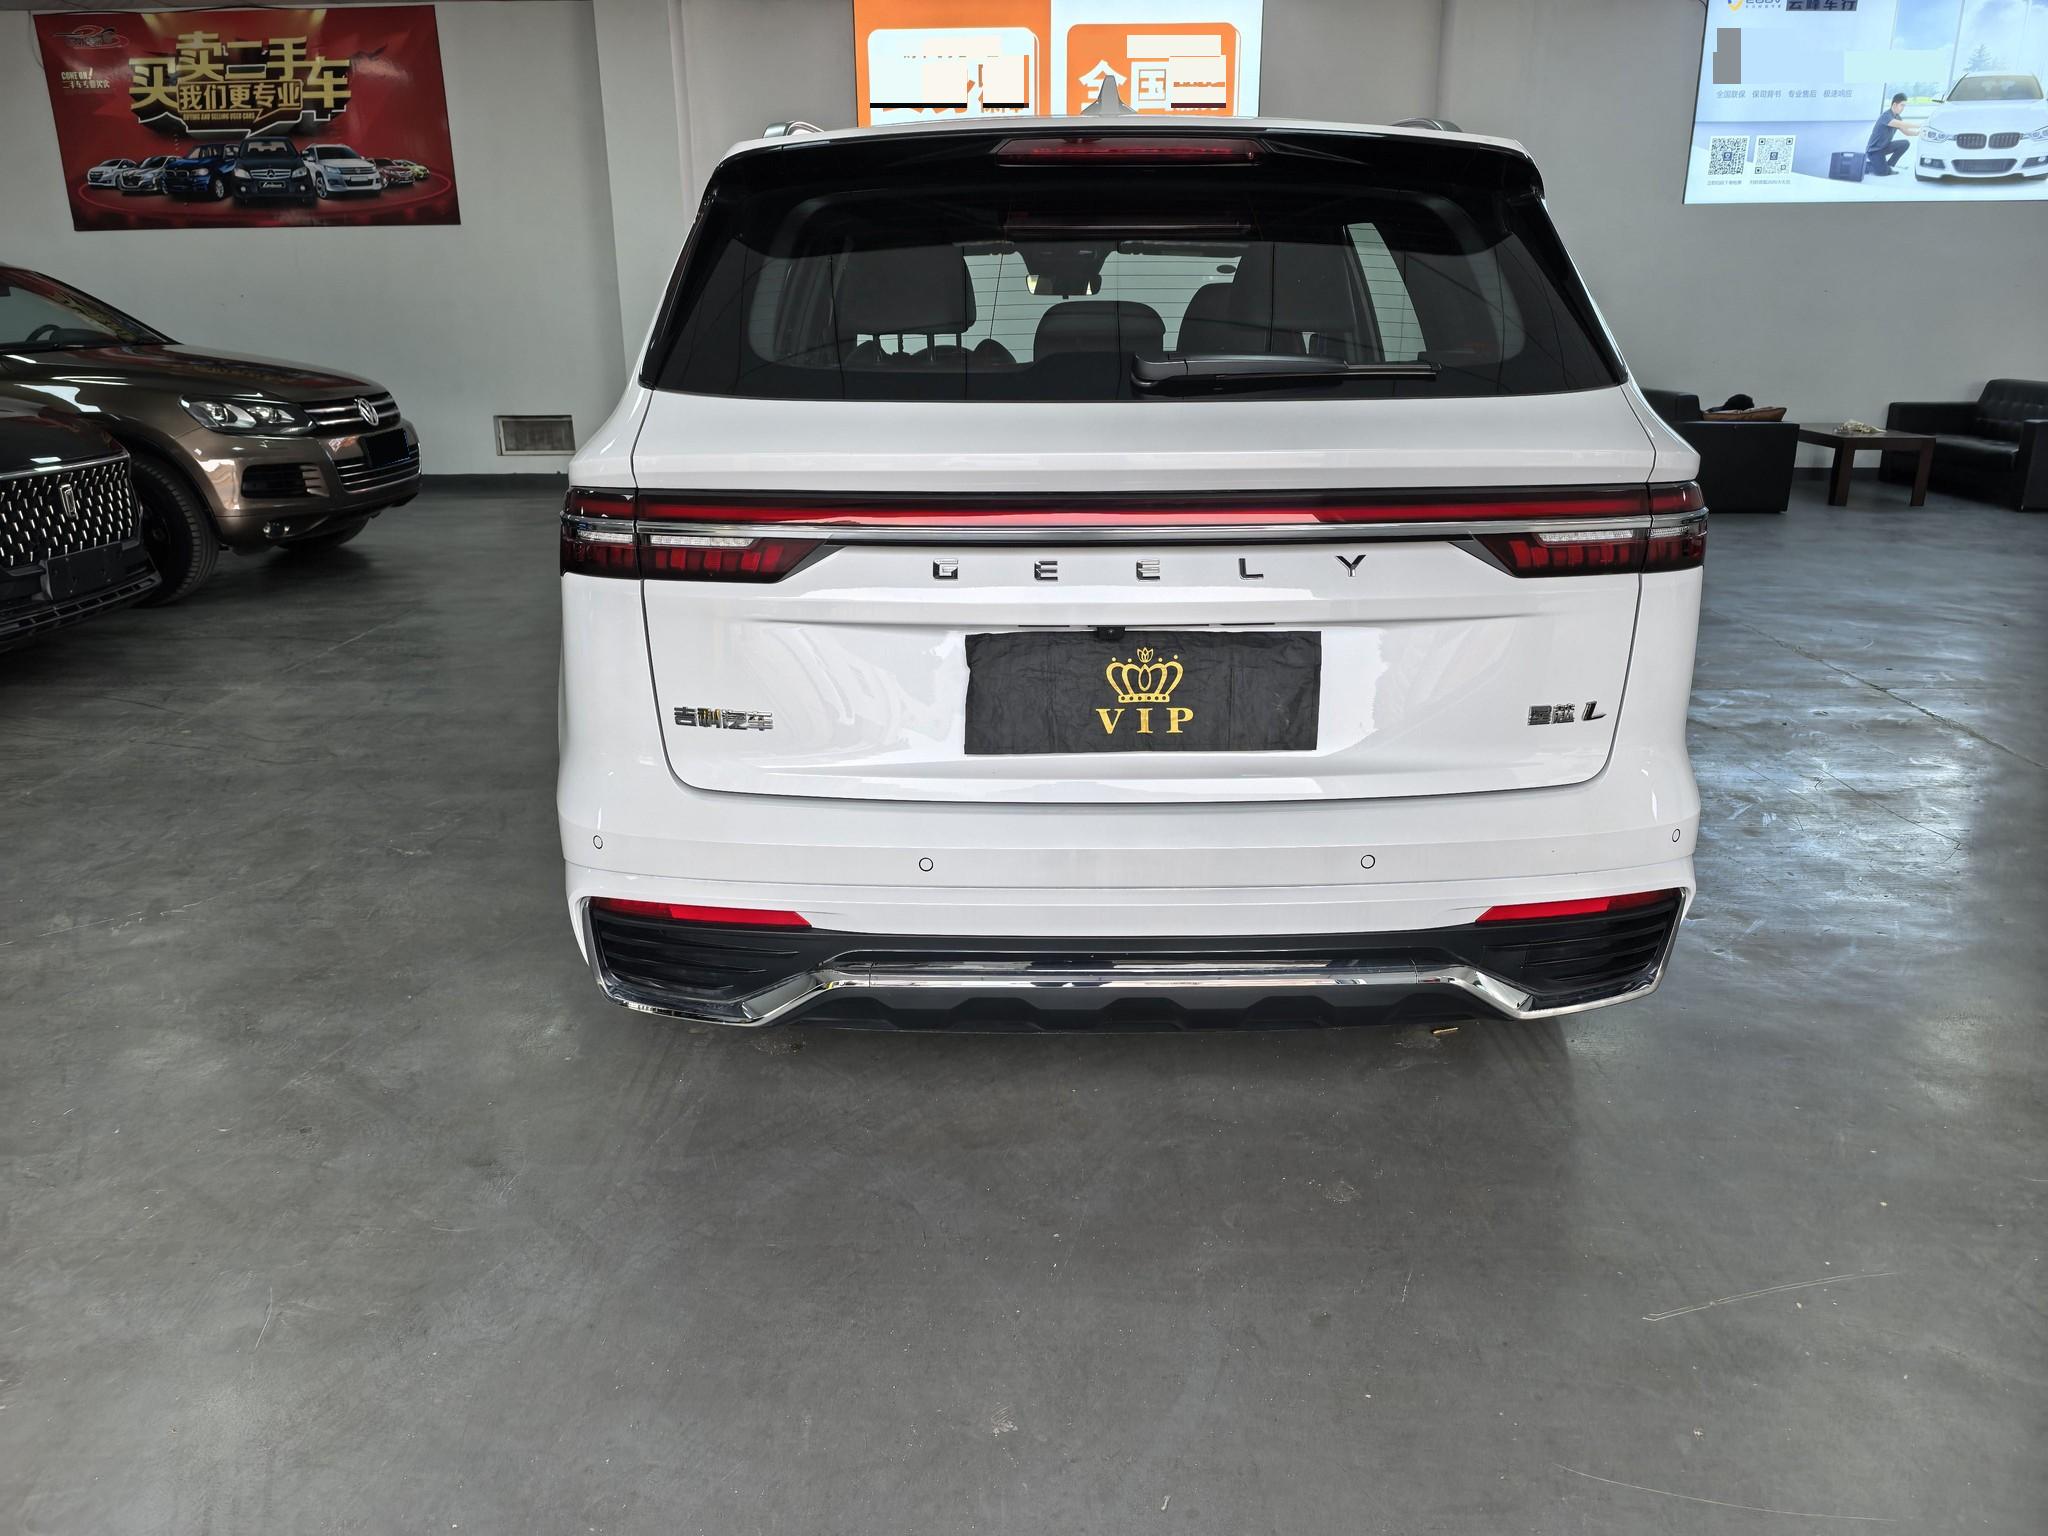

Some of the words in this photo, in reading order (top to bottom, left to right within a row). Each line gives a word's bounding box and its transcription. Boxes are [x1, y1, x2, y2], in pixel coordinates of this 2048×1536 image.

[179, 82, 301, 111] 我们更专业
[211, 112, 230, 120] SELLING
[932, 554, 1367, 581] GEELY
[1096, 706, 1194, 735] VIP
